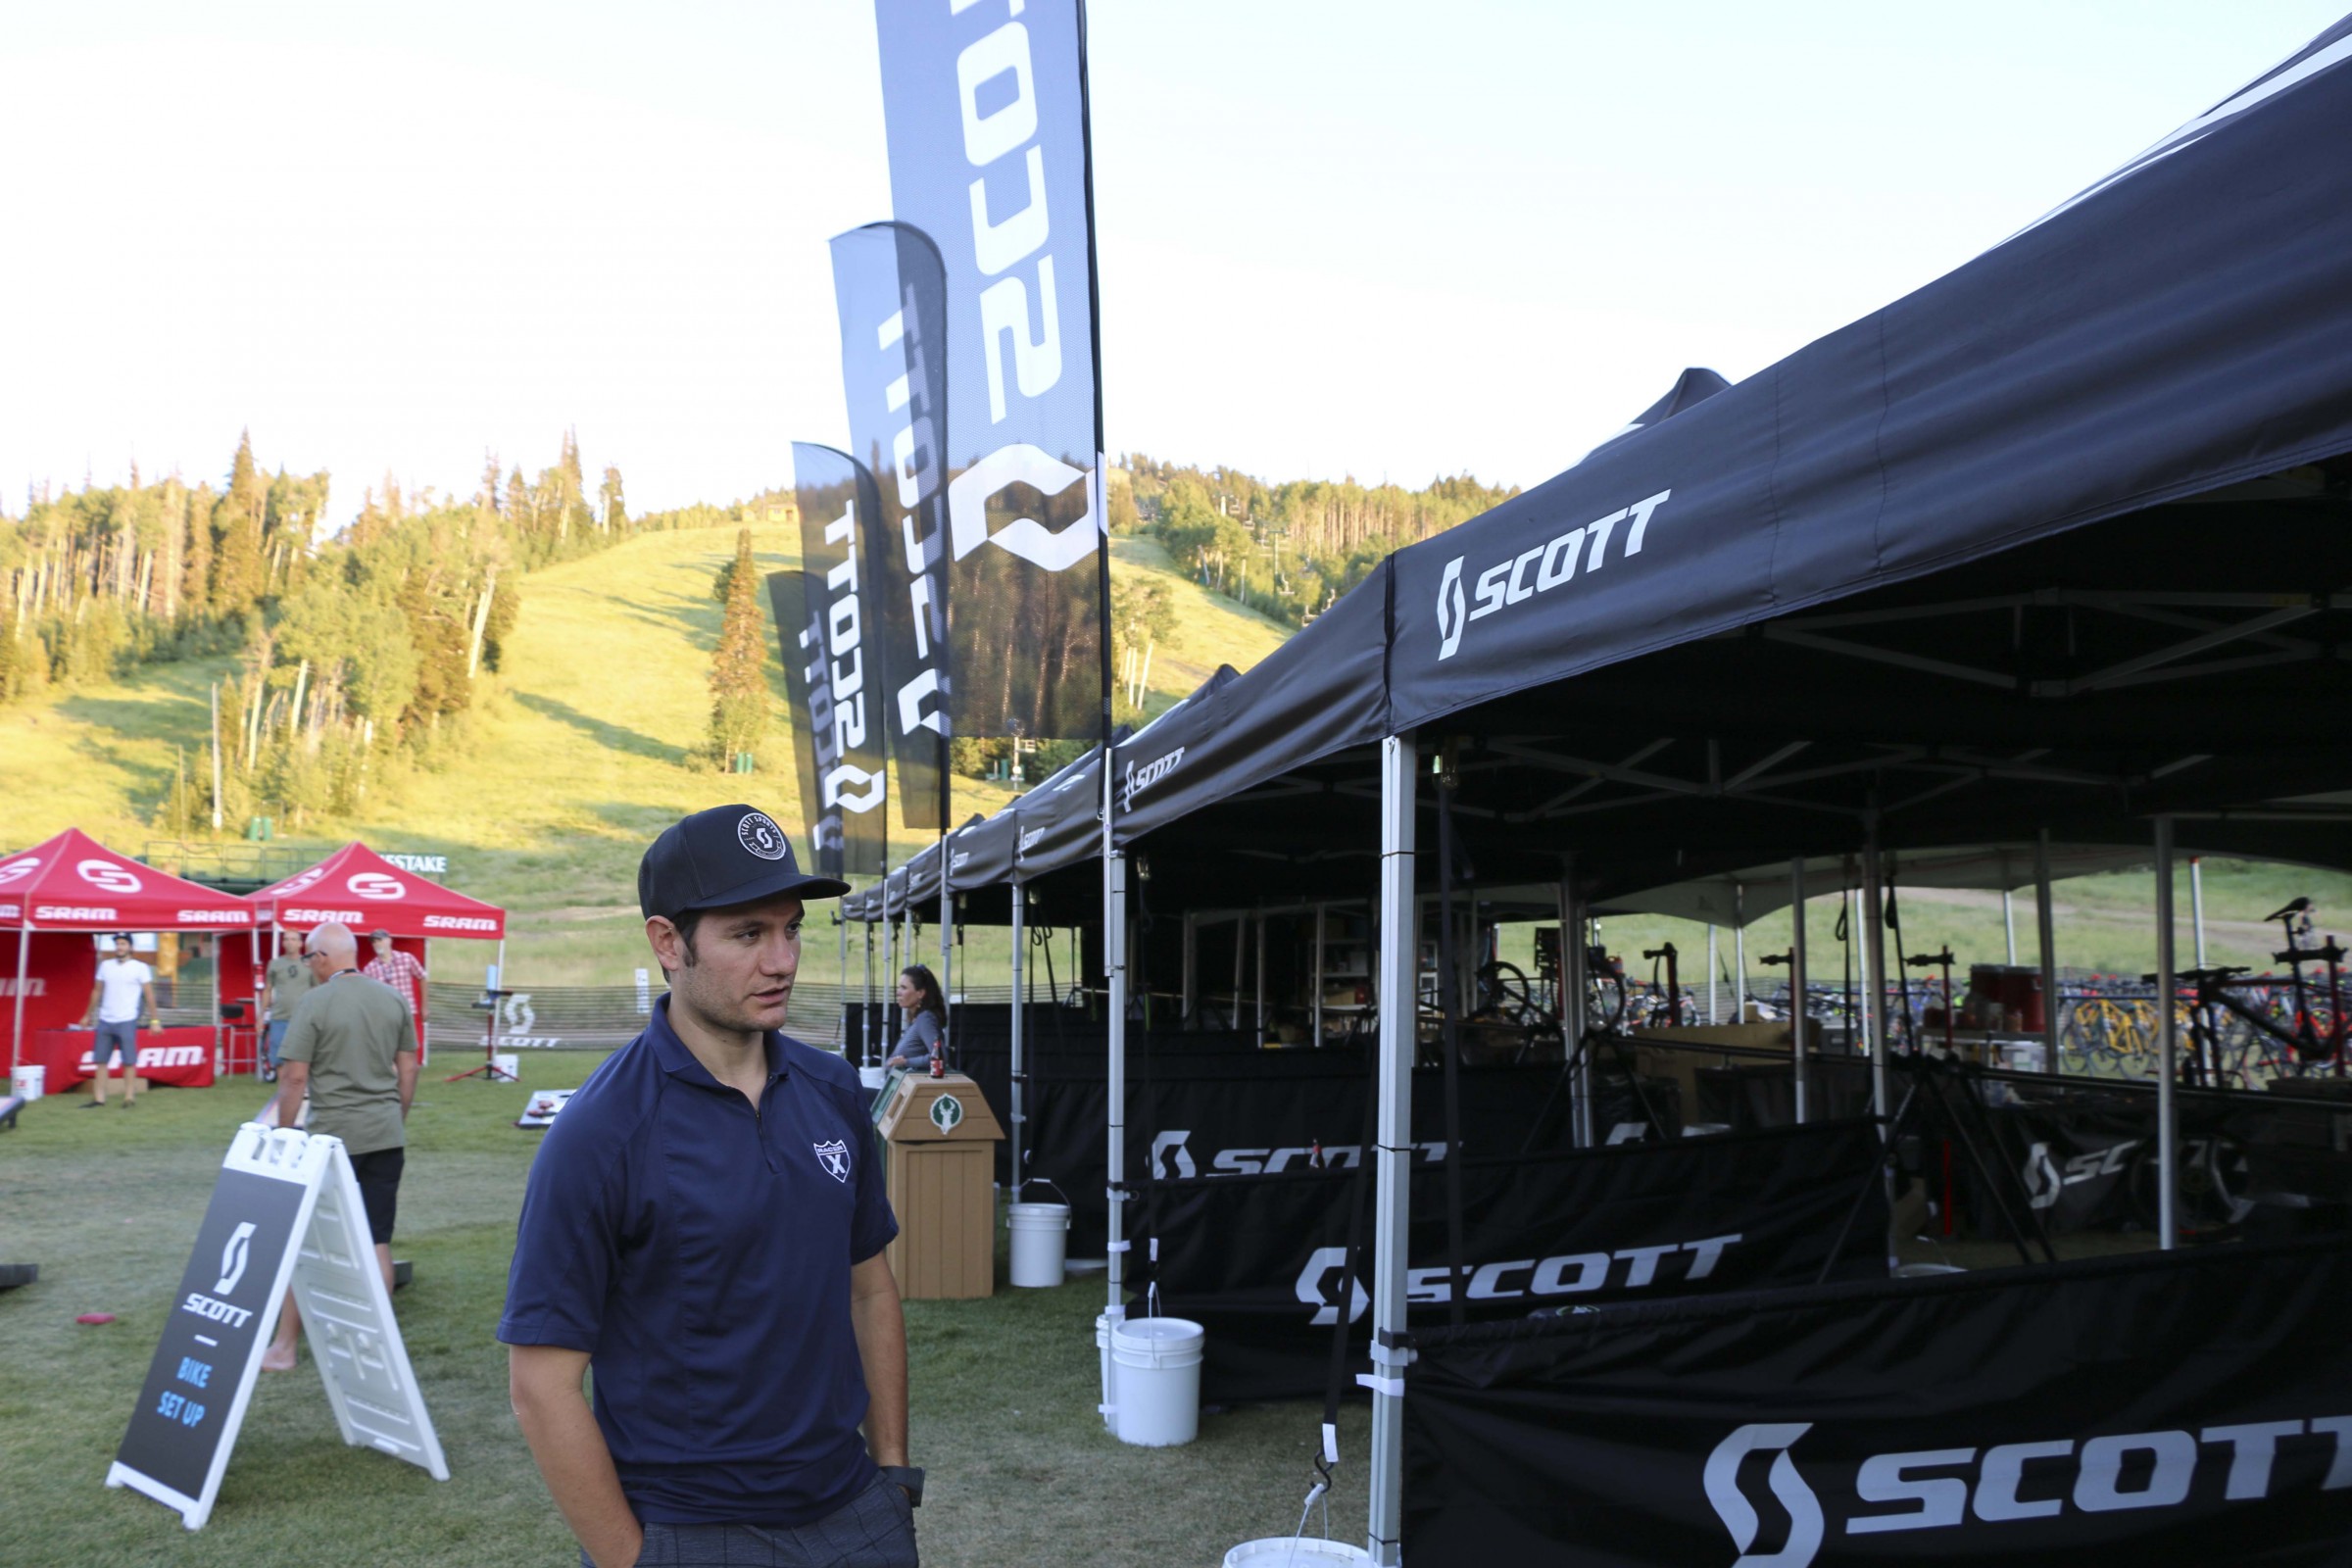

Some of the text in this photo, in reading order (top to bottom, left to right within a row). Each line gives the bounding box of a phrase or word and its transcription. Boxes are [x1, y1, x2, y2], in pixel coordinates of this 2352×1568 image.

[1468, 489, 1672, 622] SCOTT
[826, 1153, 846, 1174] X
[182, 1294, 253, 1328] SCOTT
[176, 1356, 213, 1389] BIKE
[157, 1391, 205, 1427] SET UP
